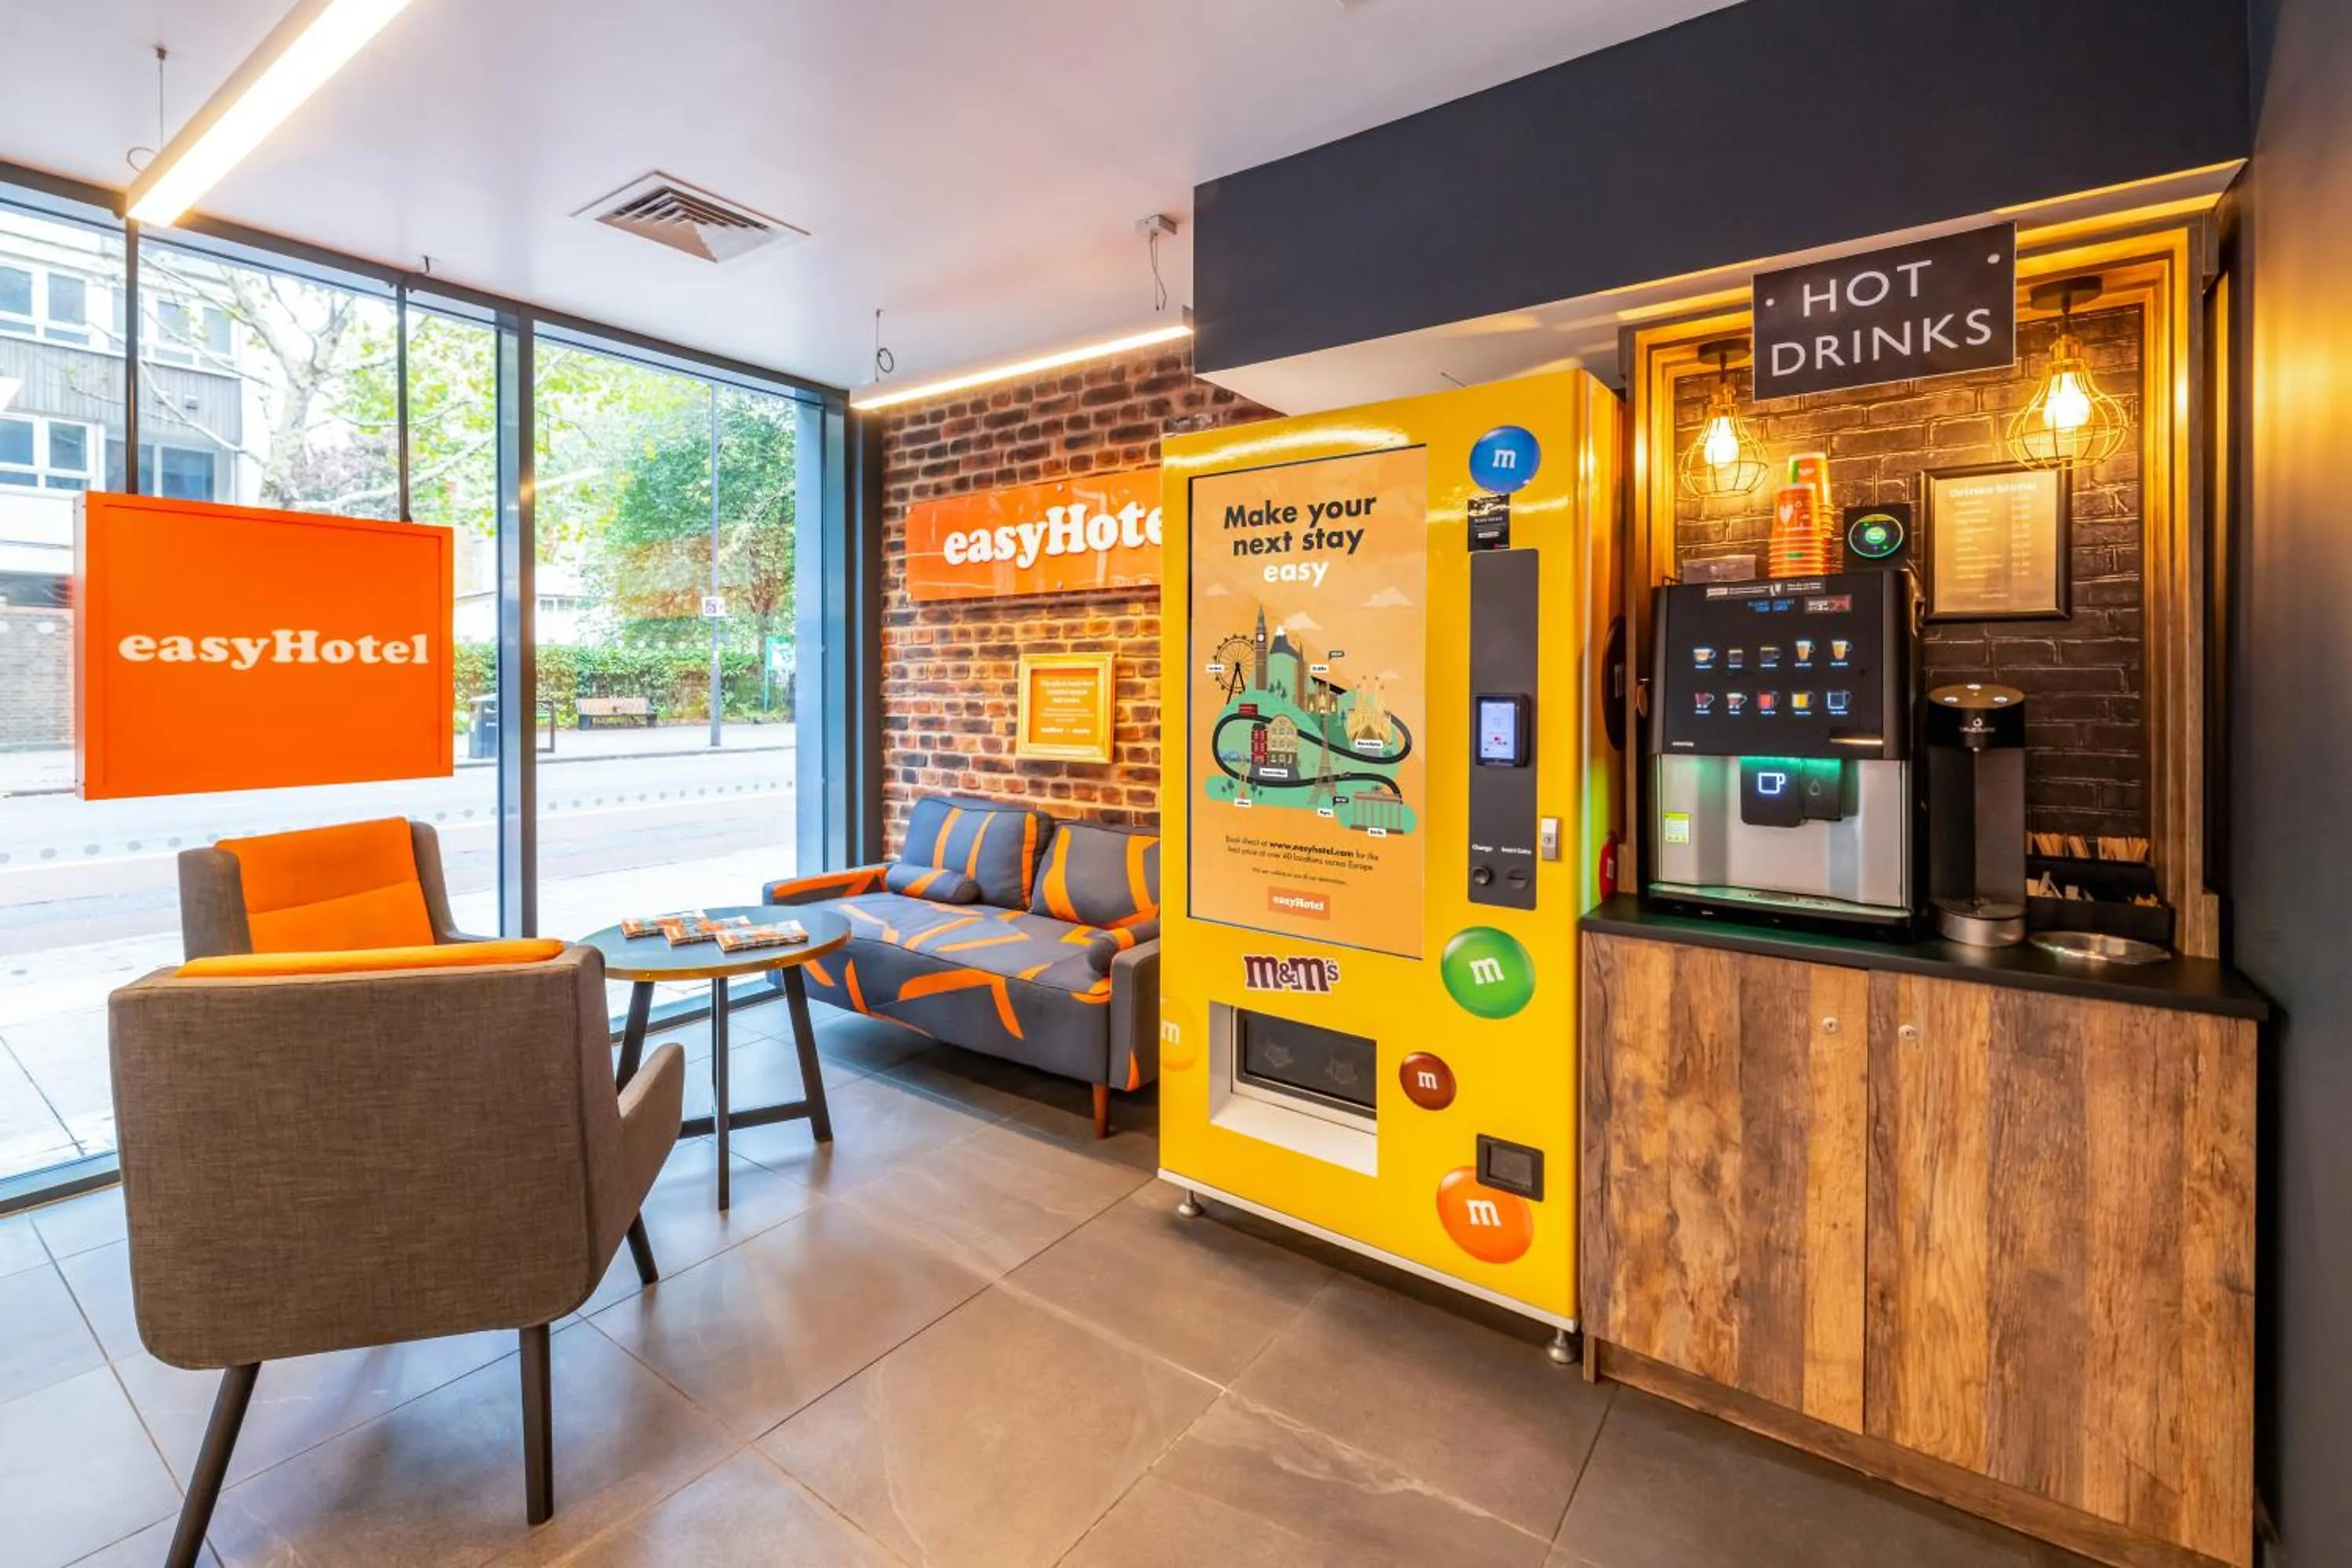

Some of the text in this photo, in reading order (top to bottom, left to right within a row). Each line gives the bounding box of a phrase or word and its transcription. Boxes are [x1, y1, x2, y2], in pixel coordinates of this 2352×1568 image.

[1802, 260, 1933, 317] HOT
[1771, 308, 1993, 376] DRINKS
[1492, 448, 1516, 469] m
[1223, 495, 1377, 530] Make your
[943, 501, 1161, 569] easyHote
[1233, 527, 1365, 557] next stay
[1263, 561, 1329, 587] easy
[118, 628, 430, 671] easyHotel
[1269, 842, 1354, 858] www.easyhotel.com
[1272, 895, 1324, 911] easyHotel
[1468, 957, 1505, 985] m
[1417, 1069, 1438, 1090] m
[1466, 1199, 1501, 1227] m
